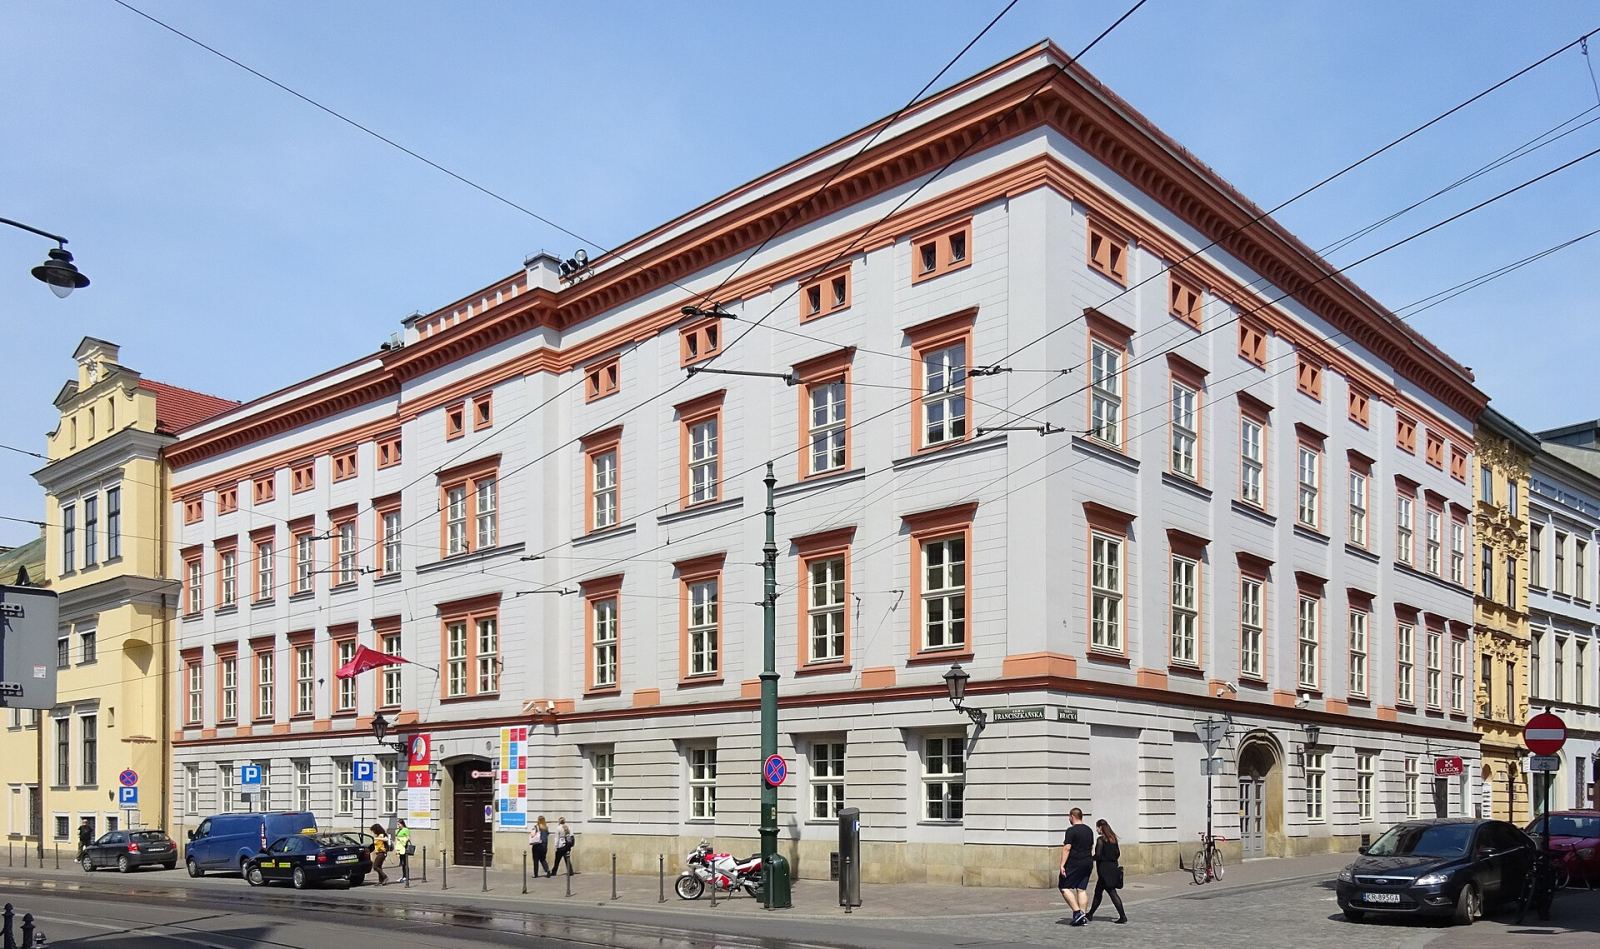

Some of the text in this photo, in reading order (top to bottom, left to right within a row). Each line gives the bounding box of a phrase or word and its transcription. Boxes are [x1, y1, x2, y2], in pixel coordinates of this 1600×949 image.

[246, 767, 257, 782] P
[357, 763, 370, 779] P
[123, 788, 134, 802] P
